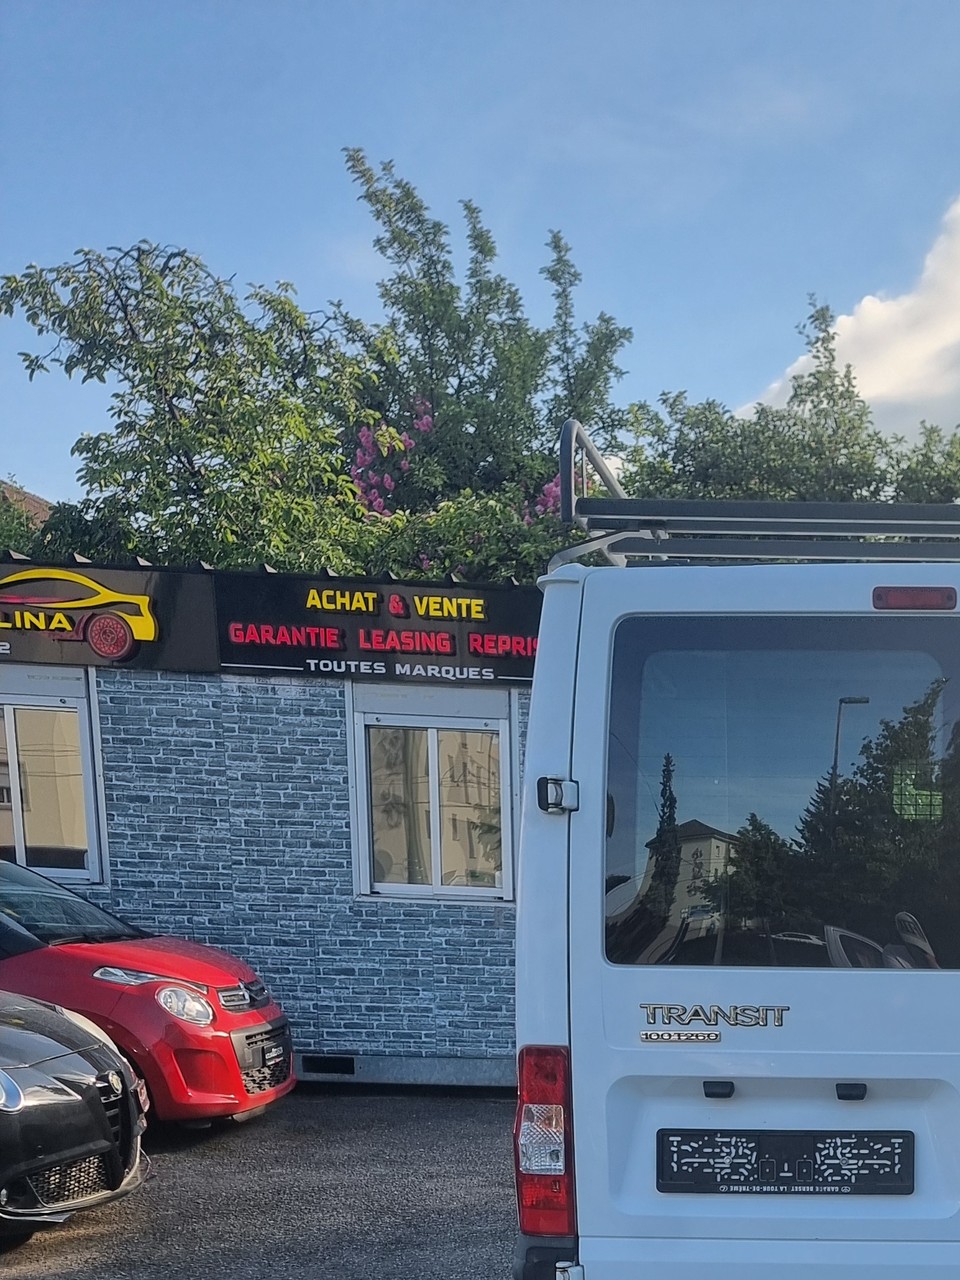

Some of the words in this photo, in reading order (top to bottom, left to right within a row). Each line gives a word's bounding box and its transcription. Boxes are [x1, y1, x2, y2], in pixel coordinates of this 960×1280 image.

[306, 589, 377, 611] ACHAT
[388, 594, 404, 614] &
[414, 595, 484, 619] VENTE
[229, 622, 340, 648] GARANTIE
[359, 628, 450, 653] LEASING
[305, 658, 386, 674] TOUTES
[395, 663, 495, 680] MARQUES
[640, 1003, 790, 1026] TRANSIT
[642, 1031, 719, 1042] 100T260
